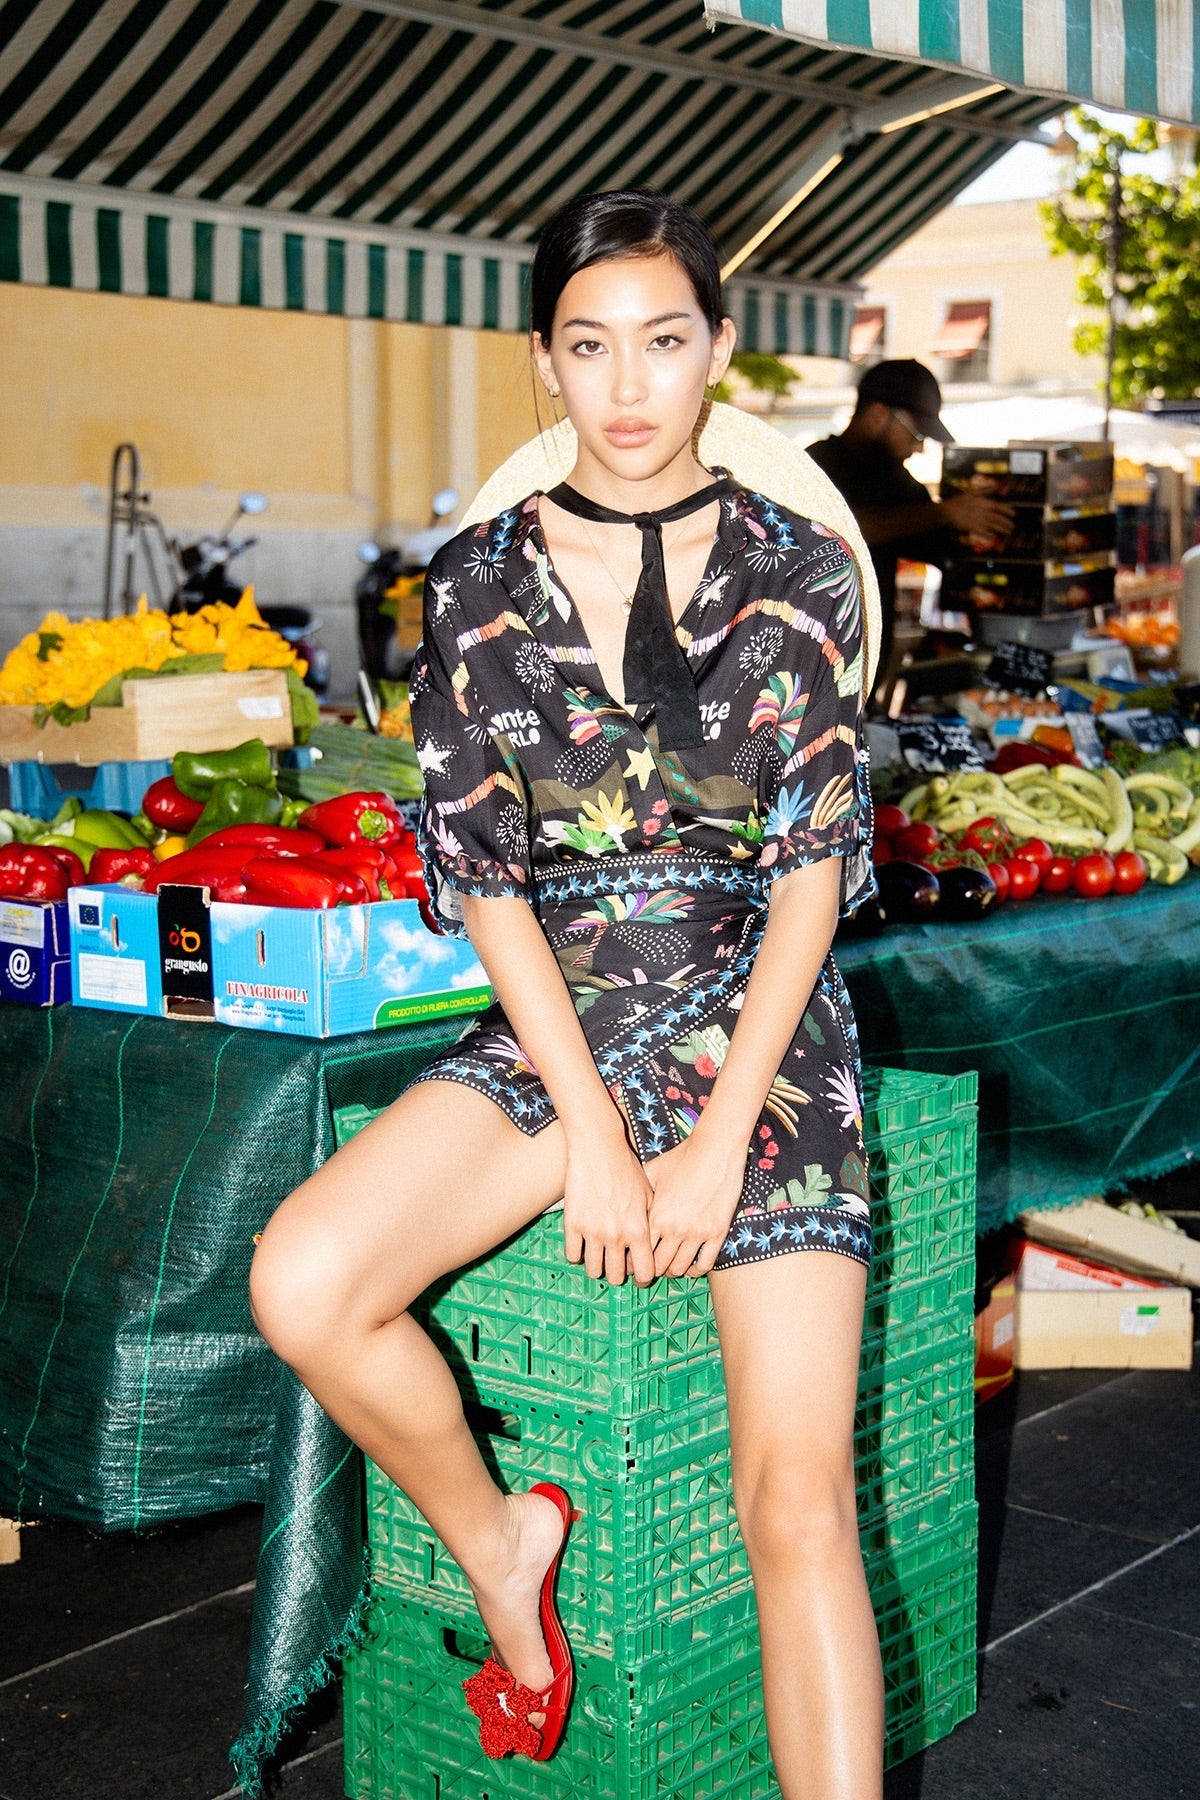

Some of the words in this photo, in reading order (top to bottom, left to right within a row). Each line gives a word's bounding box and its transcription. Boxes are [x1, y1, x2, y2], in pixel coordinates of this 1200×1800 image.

[164, 957, 209, 975] grangusto
[226, 981, 308, 1004] FINAGRICOLA
[388, 1005, 421, 1019] PRODOTTO
[421, 1004, 429, 1014] DI
[449, 994, 489, 1009] CONTROLLATA
